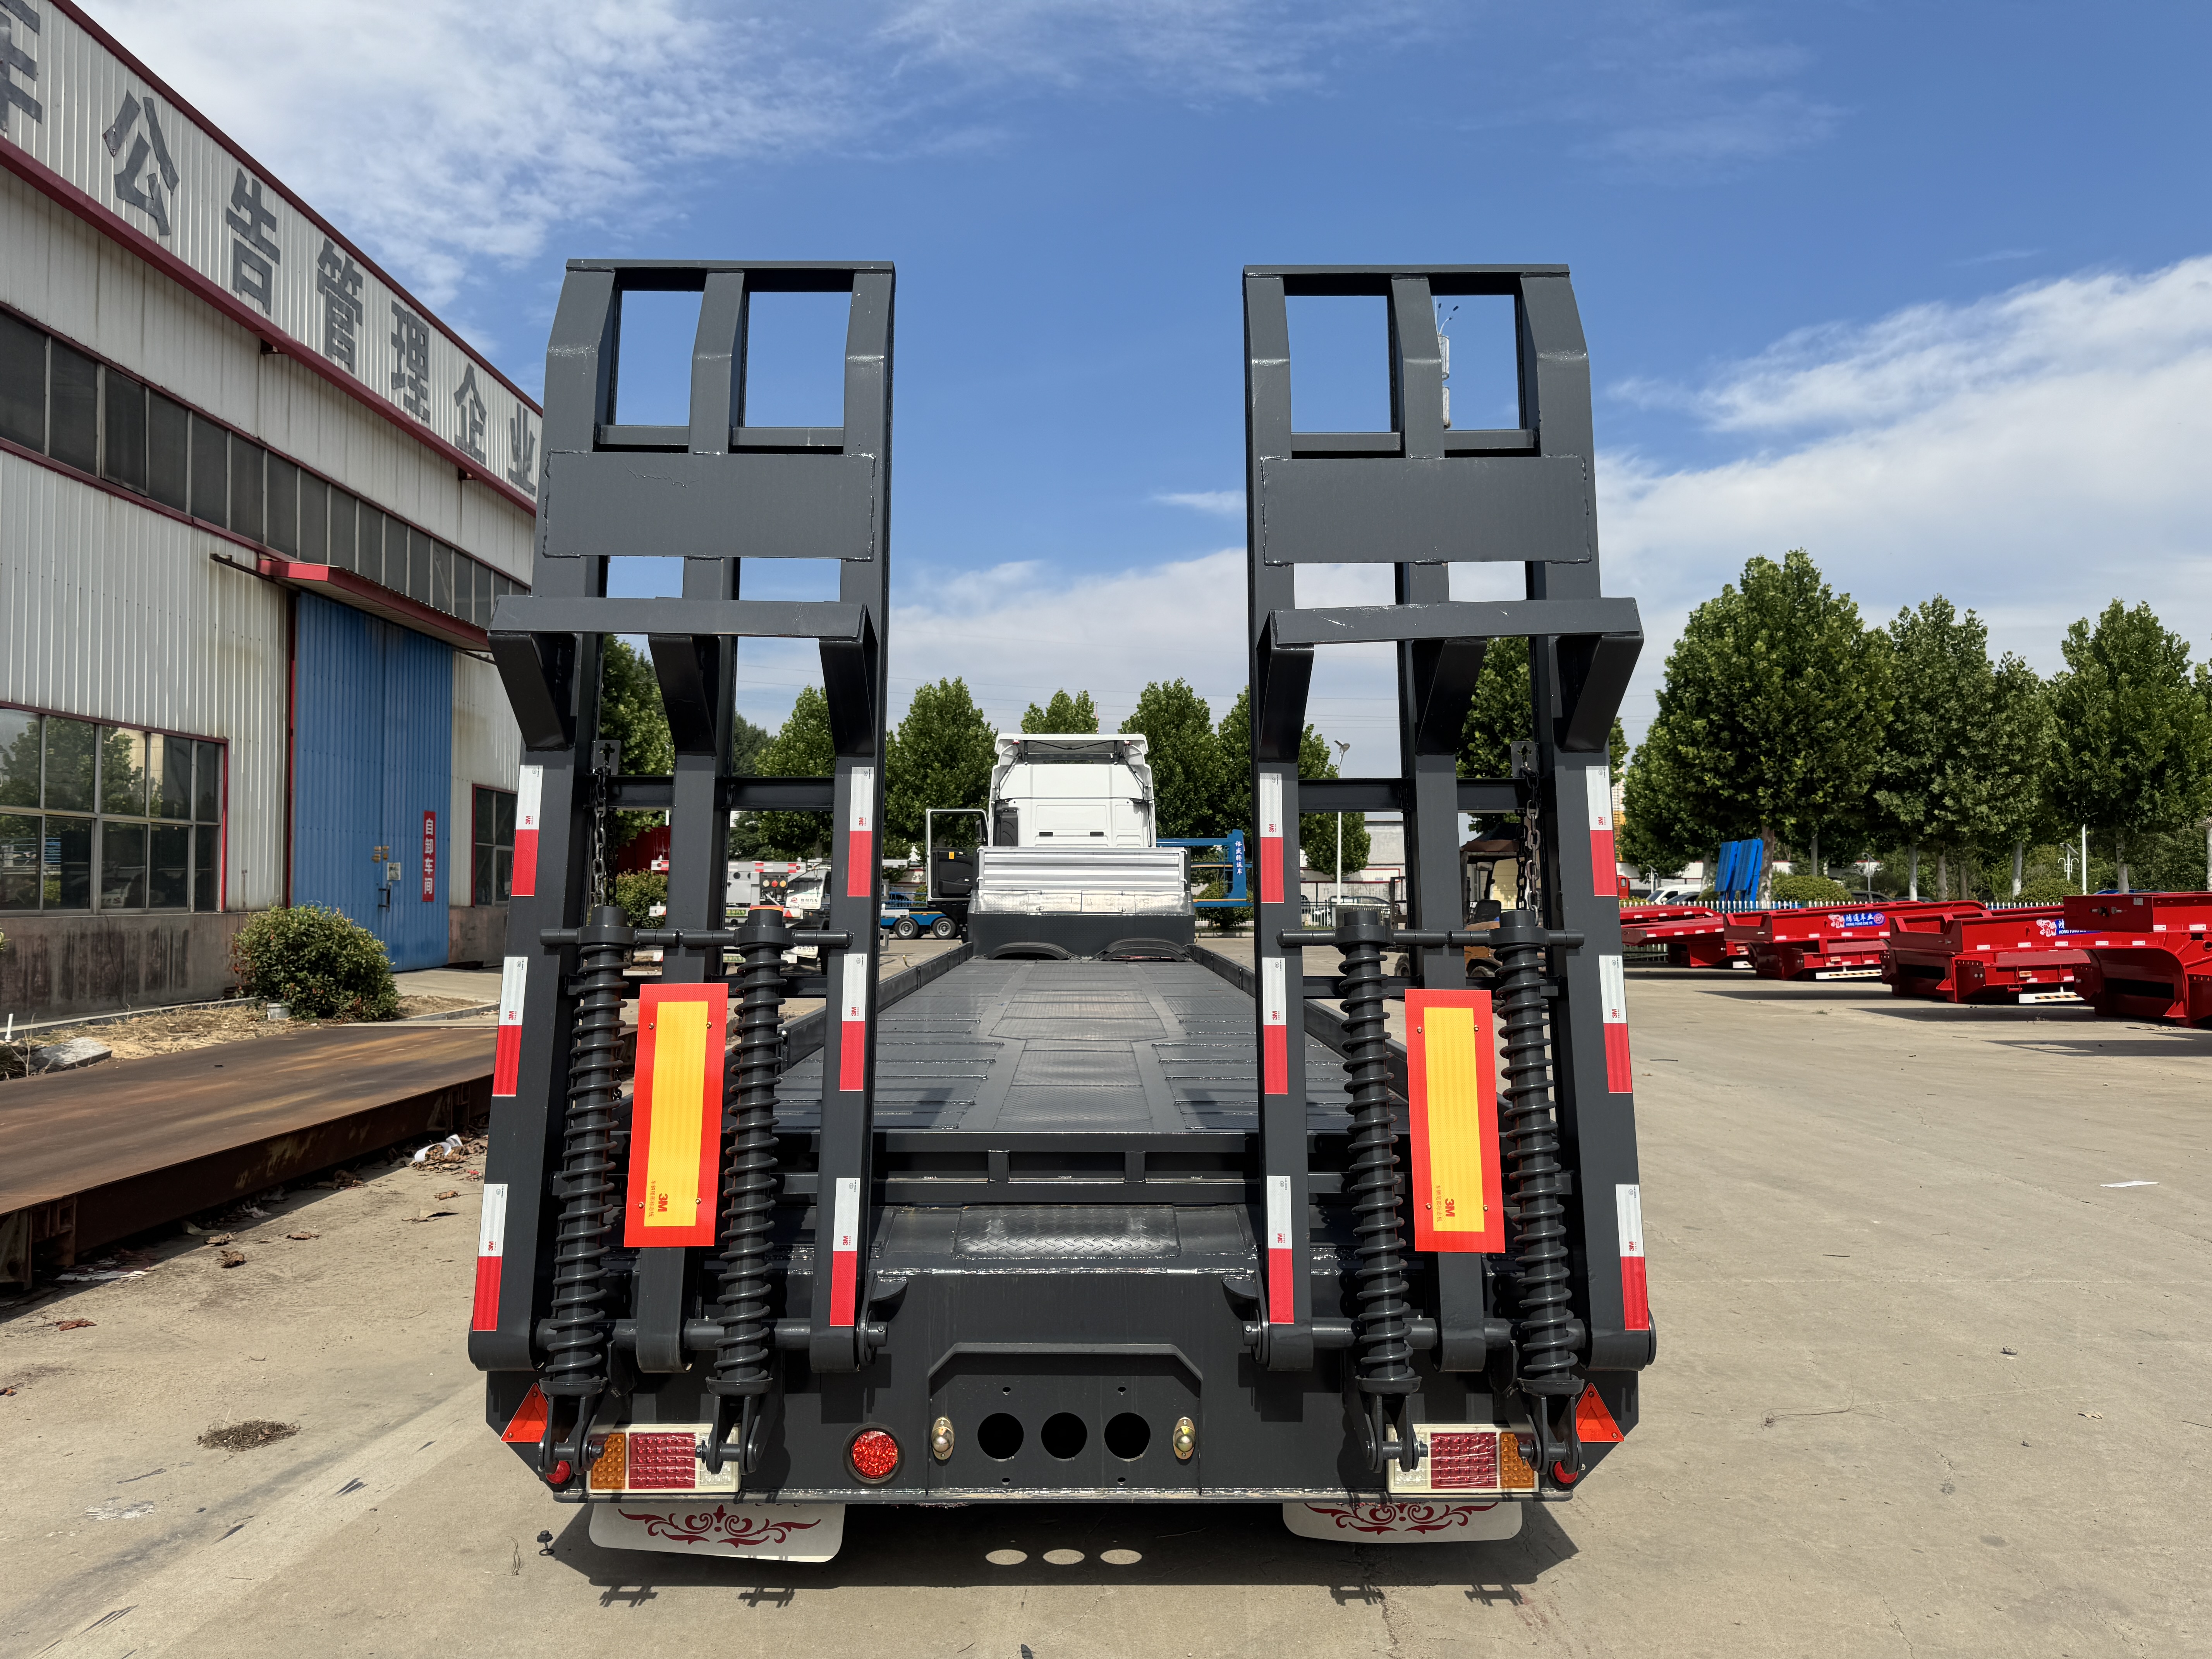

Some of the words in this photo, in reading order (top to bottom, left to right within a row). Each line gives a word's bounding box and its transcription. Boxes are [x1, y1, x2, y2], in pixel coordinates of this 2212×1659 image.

[526, 816, 531, 824] 3M
[859, 817, 864, 826] 3M
[1598, 816, 1603, 825] 3M
[1269, 824, 1274, 832] 3M
[425, 818, 433, 894] 自卸车间
[508, 1011, 514, 1020] 3M
[851, 1006, 857, 1016] 3M
[1272, 1011, 1277, 1020] 3M
[1612, 1009, 1617, 1018] 3M
[658, 1193, 668, 1212] 3M
[1445, 1198, 1455, 1217] 3M
[843, 1235, 848, 1246] 3M
[1277, 1233, 1283, 1243] 3M
[488, 1241, 494, 1251] 3M
[1629, 1241, 1634, 1251] 3M
